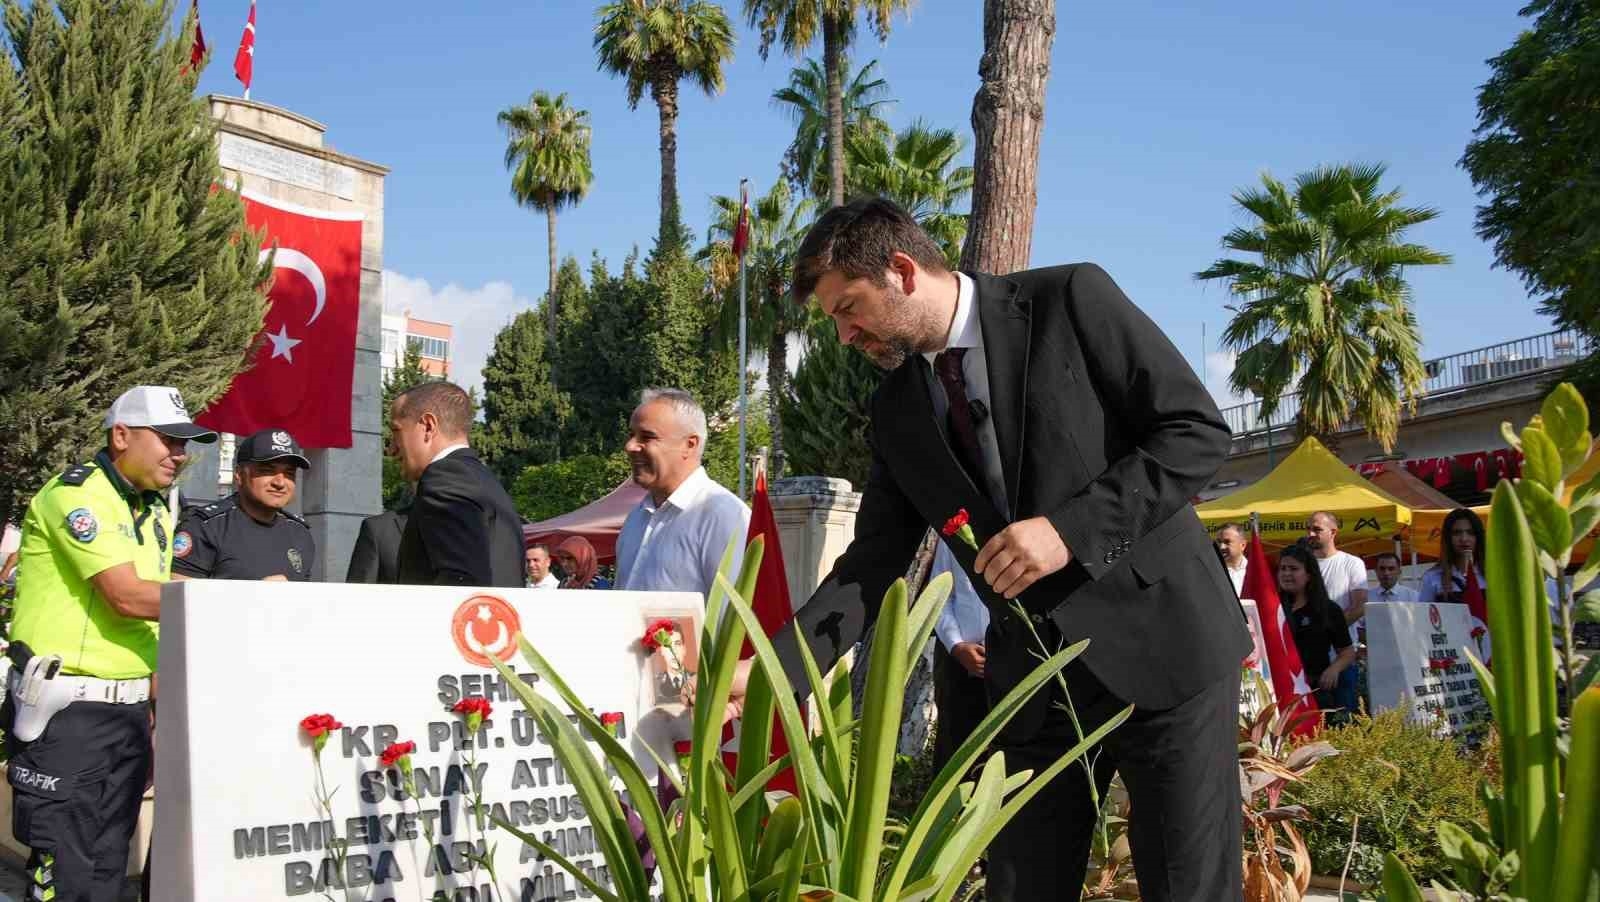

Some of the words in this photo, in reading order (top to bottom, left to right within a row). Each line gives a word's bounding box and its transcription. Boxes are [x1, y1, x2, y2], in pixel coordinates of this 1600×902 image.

[428, 719, 505, 752] PLT.
[360, 762, 488, 804] SUNAY
[233, 799, 452, 859] MEMLEKETİ
[284, 849, 403, 896] BABA
[424, 839, 489, 877] ADI
